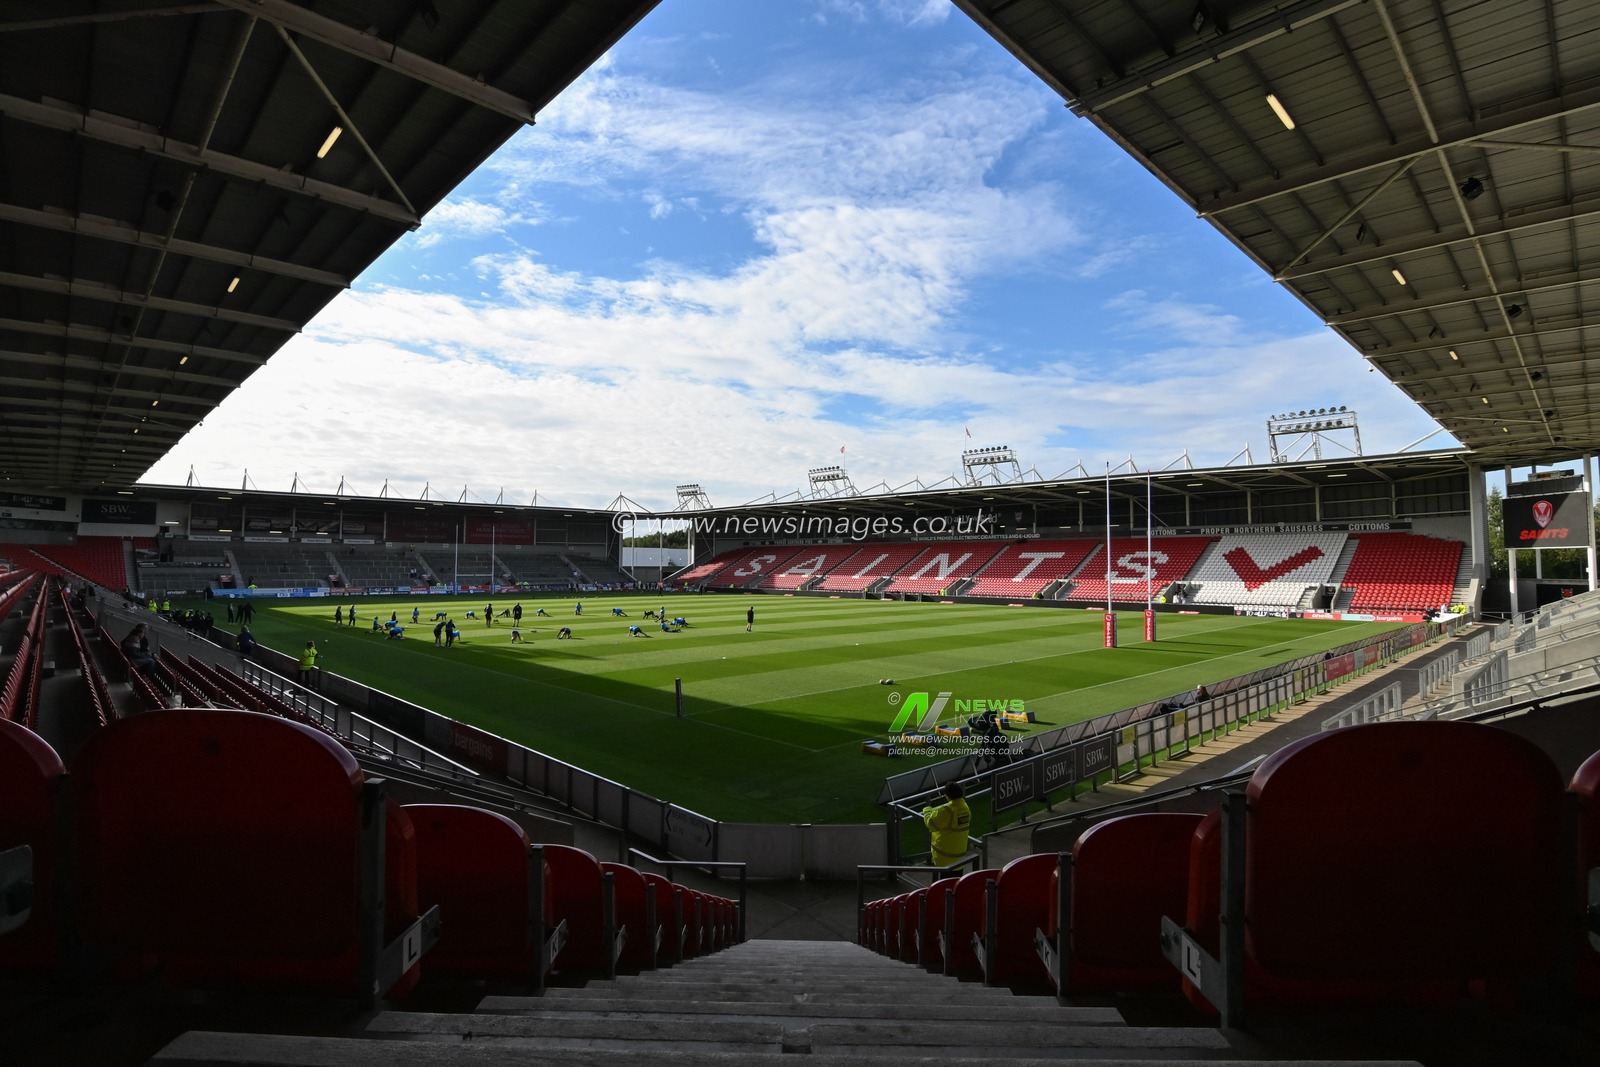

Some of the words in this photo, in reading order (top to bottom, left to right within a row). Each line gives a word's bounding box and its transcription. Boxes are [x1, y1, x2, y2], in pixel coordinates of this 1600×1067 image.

[101, 503, 131, 514] SBW
[1200, 527, 1230, 535] PROPER
[1234, 525, 1275, 534] NORTHERN
[1279, 524, 1324, 533] SAUSAGES
[1348, 522, 1390, 531] COTTOMS
[1519, 528, 1569, 541] SAINTS
[455, 728, 494, 761] bargains
[1086, 747, 1104, 767] SBW
[1046, 760, 1067, 782] SBW
[999, 776, 1025, 800] SBW
[408, 937, 417, 962] L
[1044, 945, 1050, 963] K
[1187, 945, 1197, 979] L
